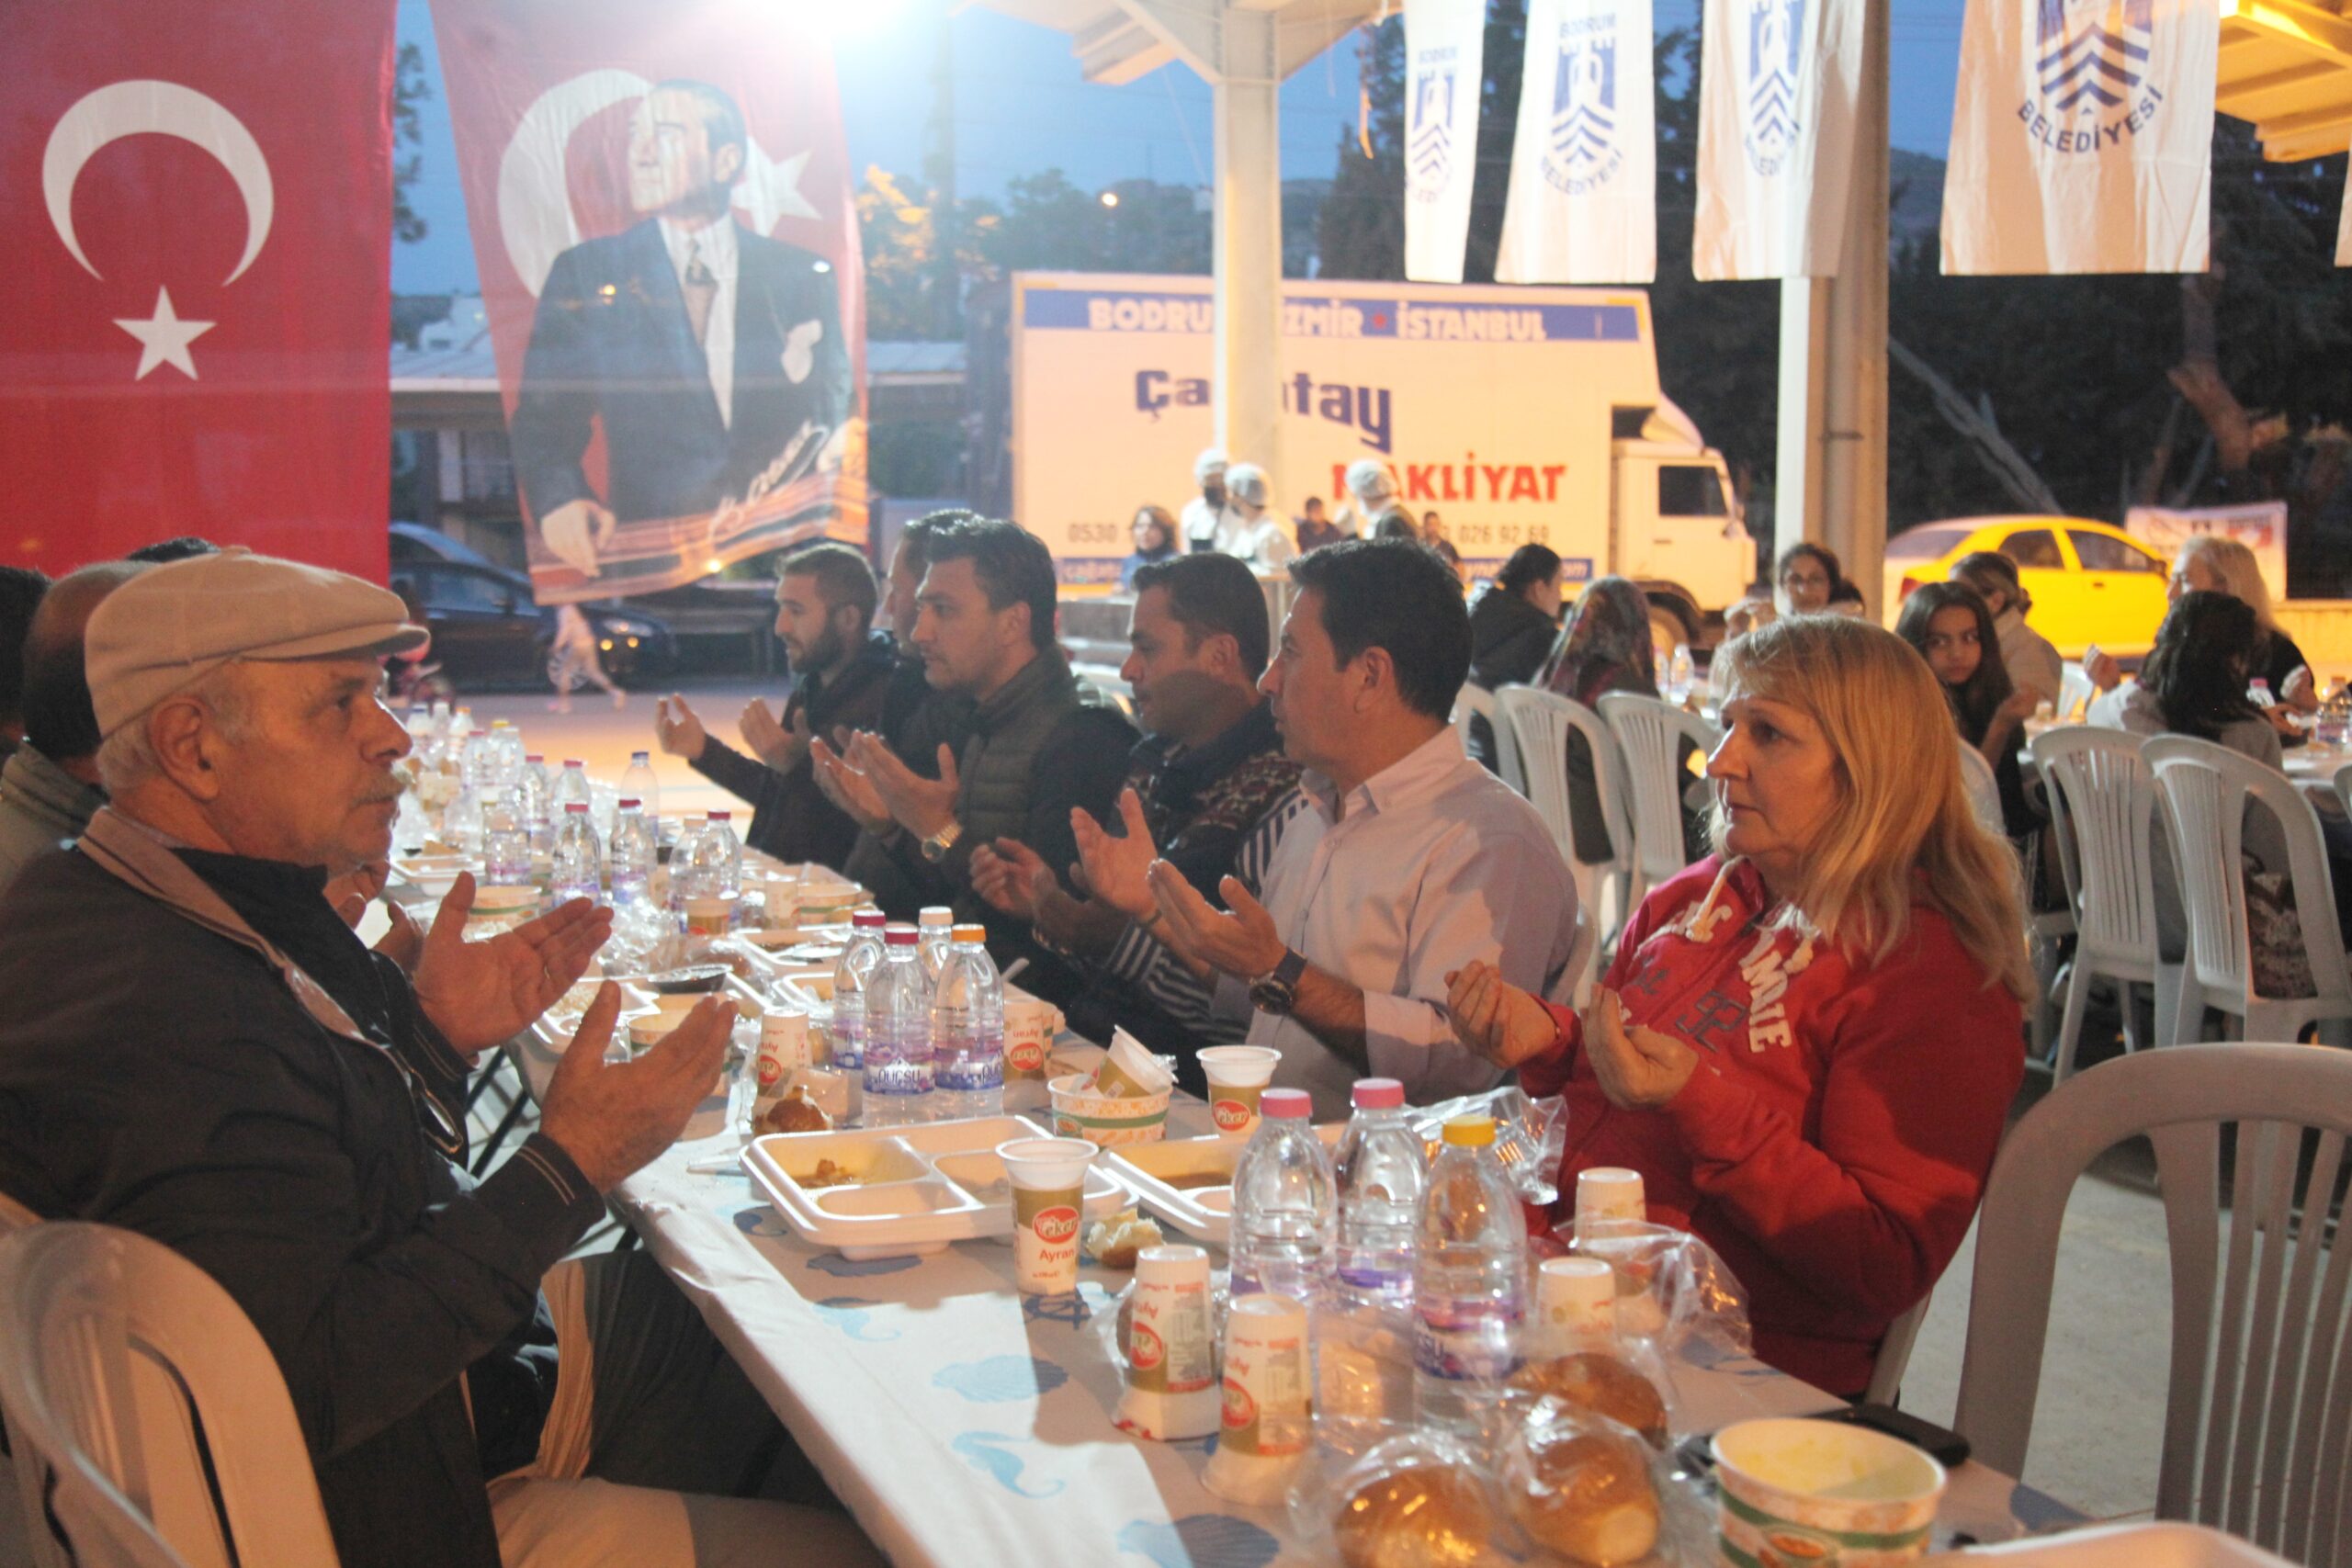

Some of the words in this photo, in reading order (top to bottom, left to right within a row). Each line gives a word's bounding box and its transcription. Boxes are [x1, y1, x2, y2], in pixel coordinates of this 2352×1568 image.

[1088, 298, 1213, 333] BODRU
[1283, 299, 1364, 339] ZMİR
[1396, 301, 1547, 341] İSTANBUL
[1136, 369, 1392, 455] Çatay
[1039, 1248, 1075, 1263] Ayran
